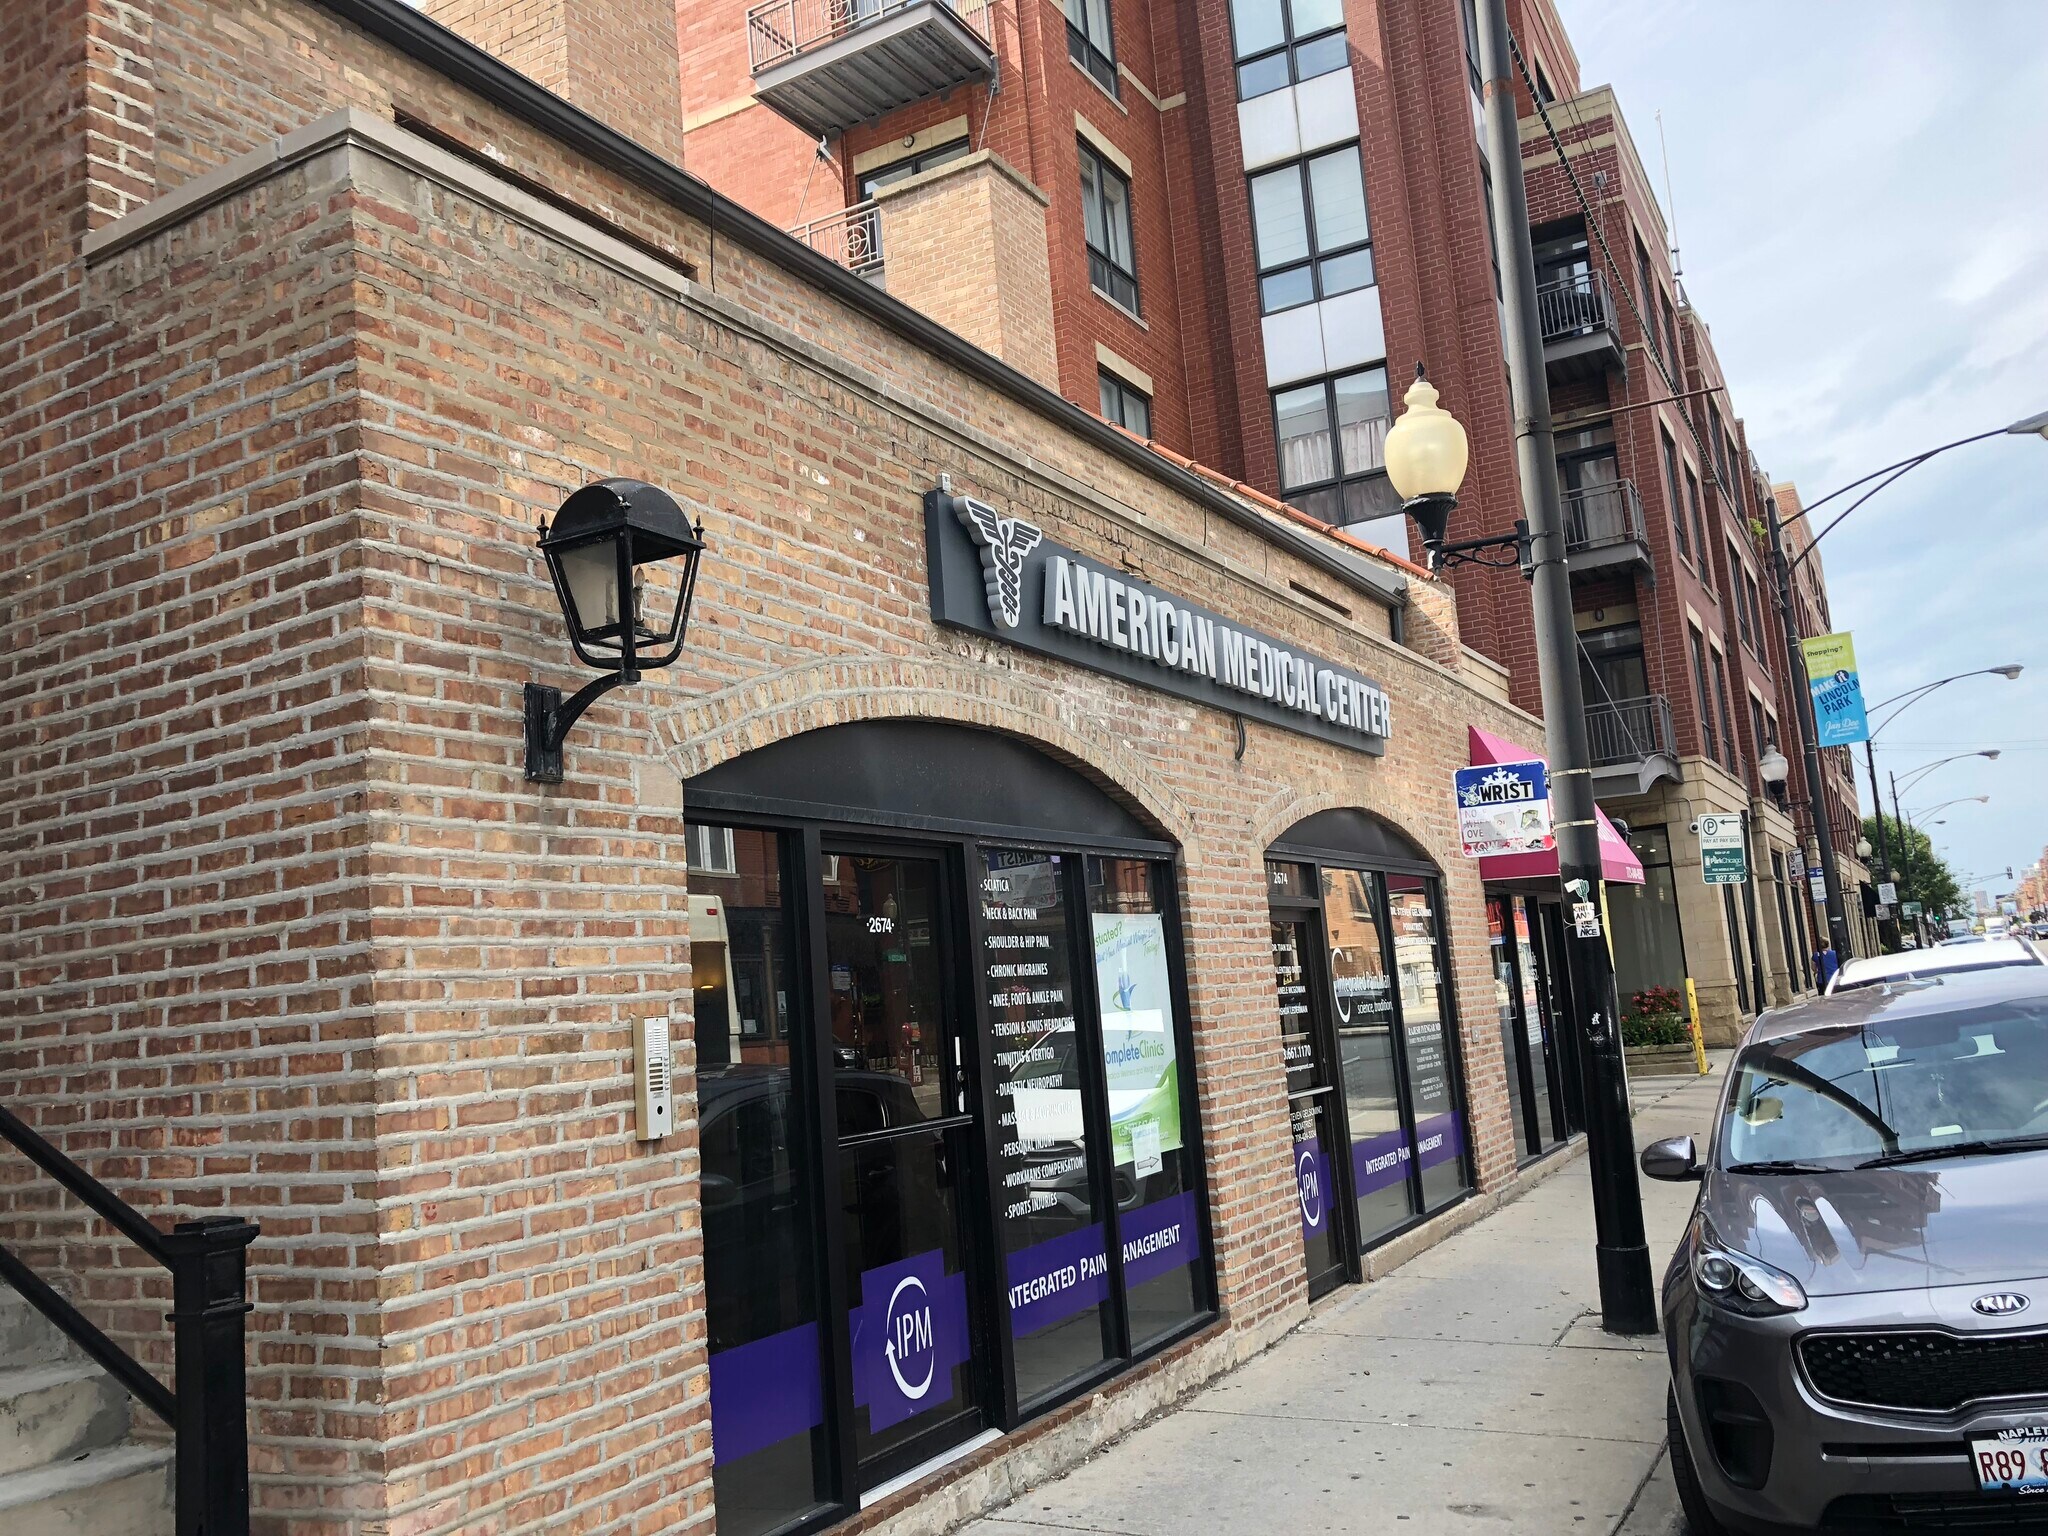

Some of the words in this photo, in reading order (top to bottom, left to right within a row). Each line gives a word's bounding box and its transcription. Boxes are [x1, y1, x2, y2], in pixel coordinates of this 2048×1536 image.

[1044, 555, 1217, 679] AMERICAN
[1214, 625, 1321, 716] MEDICAL
[1317, 669, 1391, 739] CENTER
[1807, 646, 1843, 657] Shopping?
[1811, 679, 1838, 696] MAKE
[1837, 671, 1847, 683] it
[1819, 679, 1860, 705] LINCOLN
[1824, 695, 1853, 715] PARK
[1480, 782, 1531, 802] WRIST
[1467, 830, 1484, 838] OVE
[983, 879, 1009, 891] SCIATICA
[1273, 873, 1288, 885] 2674
[986, 908, 1003, 920] NECK
[1008, 908, 1023, 920] BACK
[1023, 908, 1037, 920] PAIN
[988, 935, 1019, 948] SHOULDER
[1020, 935, 1025, 948] &
[1025, 935, 1035, 948] HIP
[1036, 935, 1049, 947] PAIN
[1096, 921, 1122, 947] strated?
[991, 964, 1016, 977] CHRONIC
[1017, 963, 1048, 976] MIGRAINES
[993, 994, 1010, 1007] KNEE,
[1011, 992, 1026, 1006] FOOT
[1026, 991, 1031, 1004] &
[1032, 991, 1050, 1004] ANKLE
[1050, 990, 1063, 1002] PAIN
[994, 1022, 1020, 1036] TENSION
[1021, 1020, 1026, 1033] &
[1027, 1019, 1043, 1033] SINUS
[997, 1050, 1024, 1066] TINNITUS
[1029, 1047, 1054, 1061] VERTIGO
[1105, 1040, 1165, 1067] ompleteClinics
[1000, 1080, 1026, 1096] DIABETIC
[1026, 1074, 1063, 1091] NEUROPATHY
[1003, 1139, 1035, 1157] PERSONAL
[1365, 1151, 1397, 1175] INTEGRATED
[1397, 1147, 1411, 1162] PAIN
[1006, 1167, 1041, 1188] WORKMANS
[1041, 1155, 1083, 1178] COMPENSATION
[1302, 1171, 1319, 1201] IPM
[1008, 1200, 1031, 1219] SPORTS
[1031, 1192, 1058, 1212] INJURIES
[1008, 1265, 1077, 1309] NTEGRATED
[1080, 1253, 1108, 1281] PAIN
[1122, 1224, 1181, 1264] ANAGEMENT
[1982, 1295, 2022, 1311] KIA
[896, 1306, 933, 1360] IPM
[1978, 1450, 2026, 1482] R89
[2018, 1484, 2044, 1495] Since
